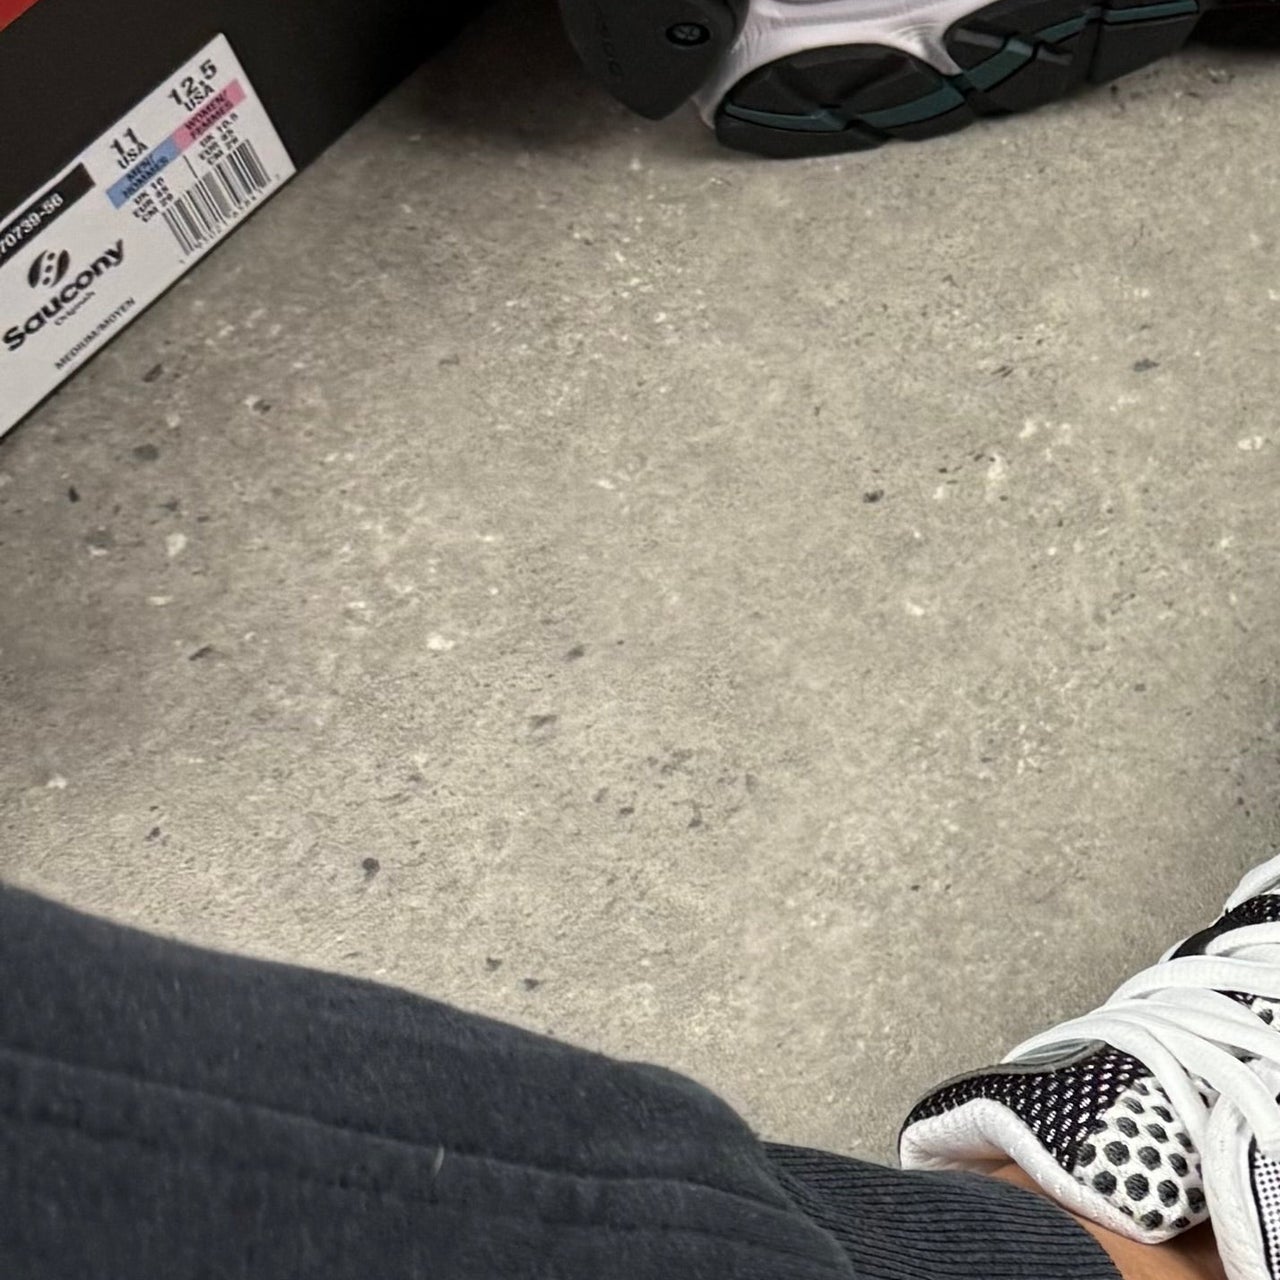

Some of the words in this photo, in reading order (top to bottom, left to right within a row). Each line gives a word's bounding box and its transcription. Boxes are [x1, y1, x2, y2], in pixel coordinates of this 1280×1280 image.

[168, 58, 217, 105] 12.5
[184, 85, 215, 112] USA
[110, 127, 138, 155] 11
[117, 142, 148, 169] USA
